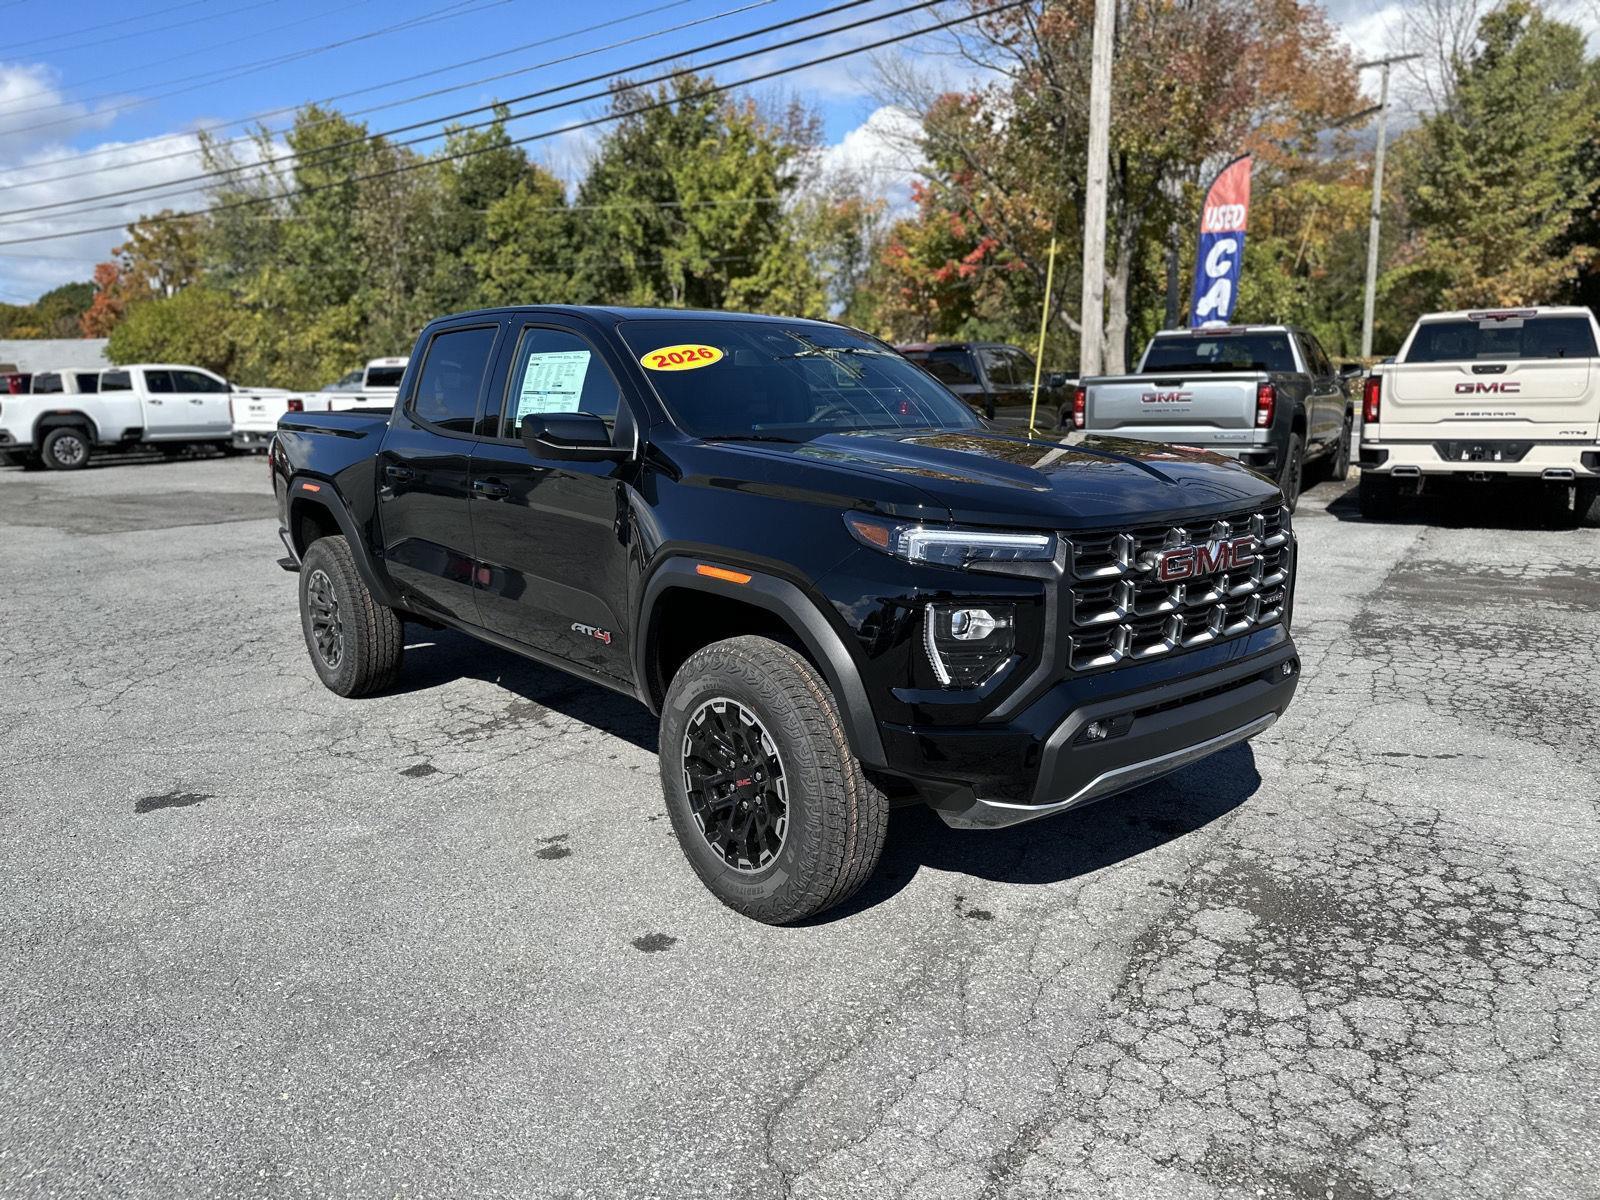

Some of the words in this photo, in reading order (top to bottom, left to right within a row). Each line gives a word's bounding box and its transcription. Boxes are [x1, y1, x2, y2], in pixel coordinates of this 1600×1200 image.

[1205, 203, 1246, 230] USED
[1196, 238, 1237, 328] CA
[652, 347, 714, 368] 2026
[1141, 391, 1193, 403] GMC
[1454, 382, 1521, 394] GMC
[1158, 535, 1255, 582] GMC
[571, 622, 611, 645] AT4
[735, 777, 752, 788] GMC
